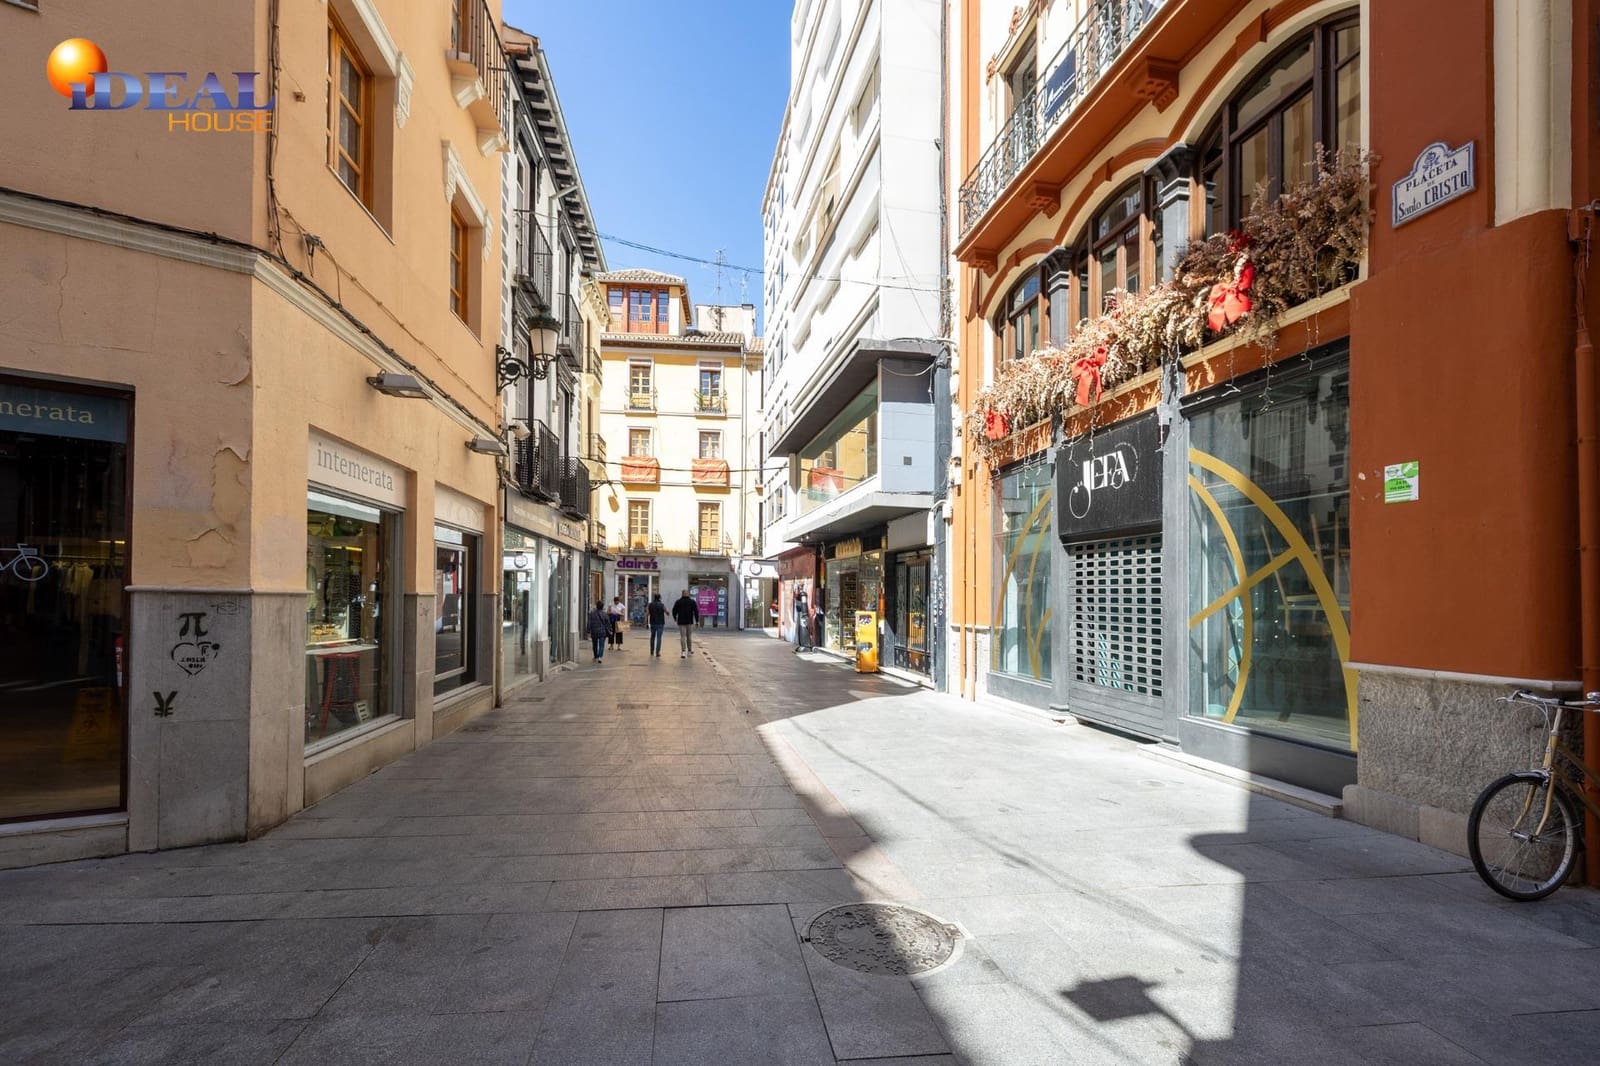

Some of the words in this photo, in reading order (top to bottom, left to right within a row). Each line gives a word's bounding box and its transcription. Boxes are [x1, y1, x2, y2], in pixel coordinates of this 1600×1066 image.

[1406, 158, 1457, 192] PLACETA
[1424, 171, 1469, 205] CRISTO
[317, 442, 394, 491] intemerata
[1069, 450, 1130, 518] JEFA
[617, 557, 658, 570] claire's
